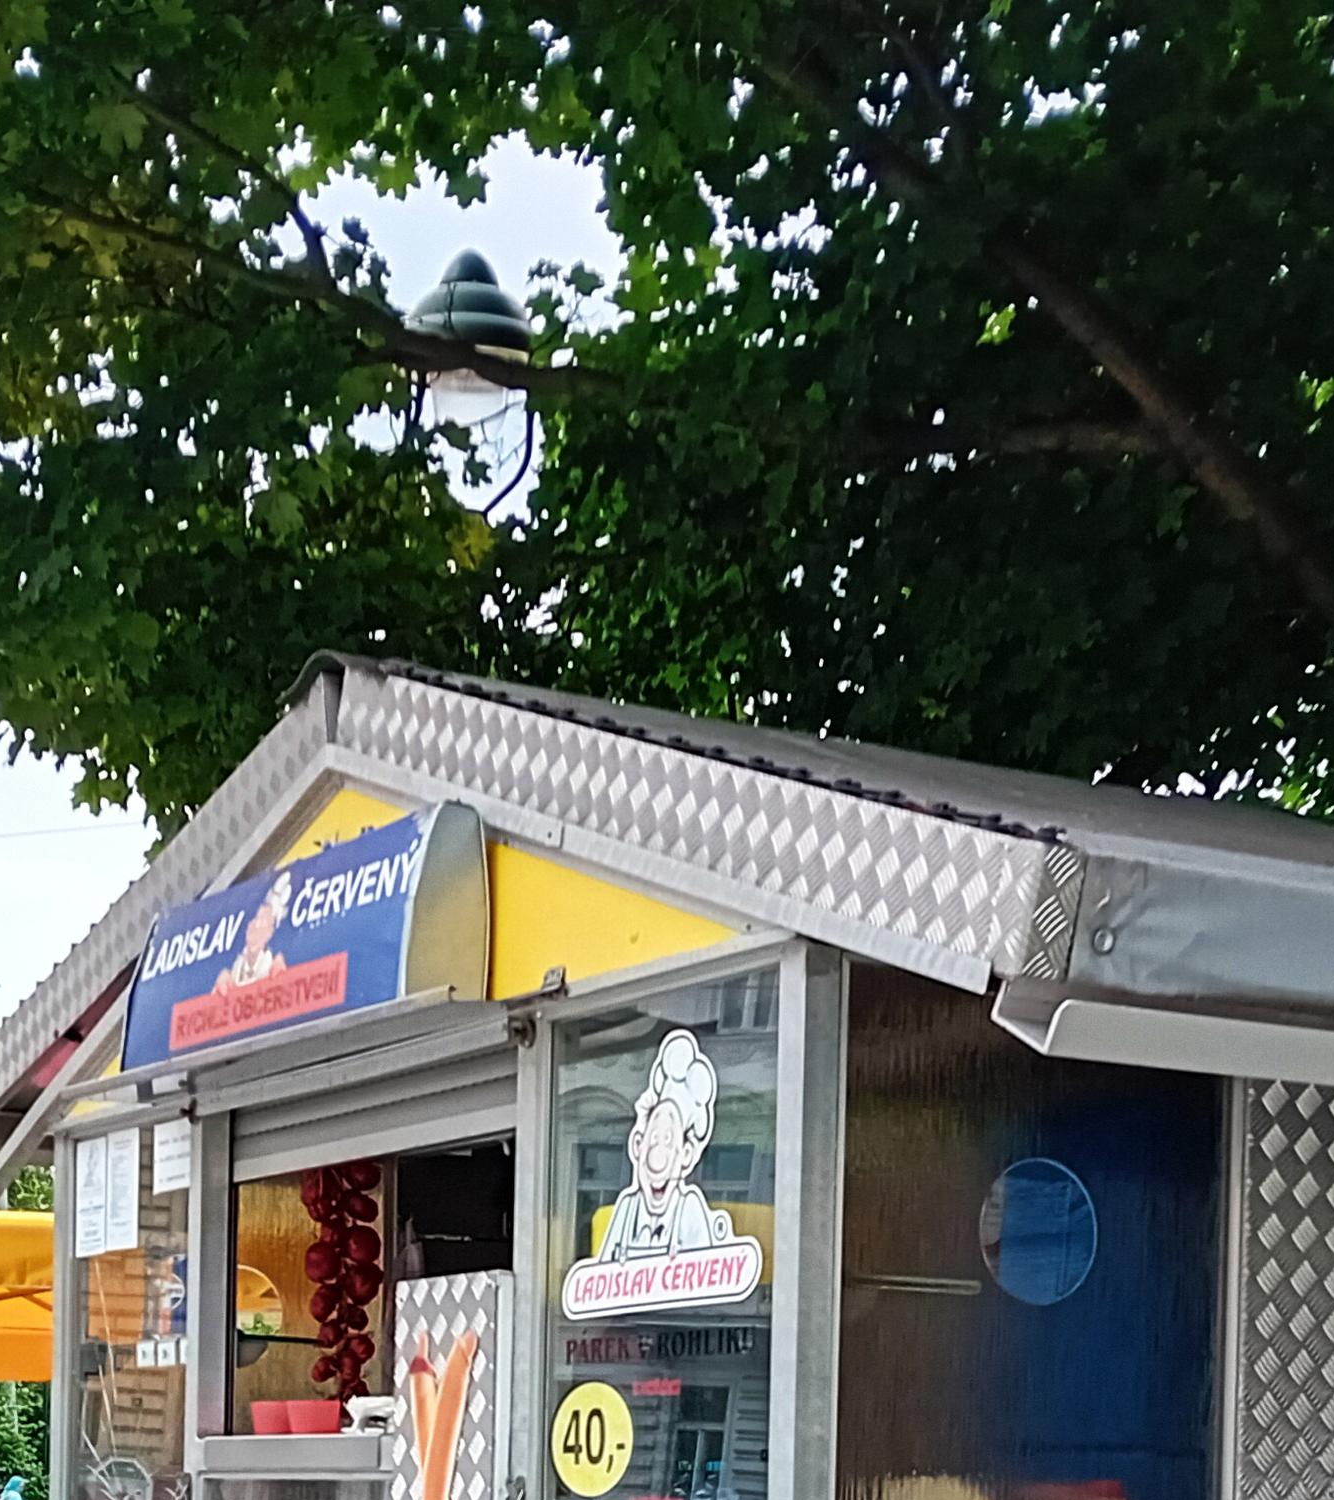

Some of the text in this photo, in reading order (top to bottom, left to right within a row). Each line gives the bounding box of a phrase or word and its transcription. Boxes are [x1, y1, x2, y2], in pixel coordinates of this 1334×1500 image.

[141, 839, 418, 982] LADISLAV ČERVENÝ
[574, 1249, 748, 1304] LADISLAV ČERVENÝ
[566, 1329, 629, 1365] PÁREK
[563, 1408, 626, 1474] 40,-
